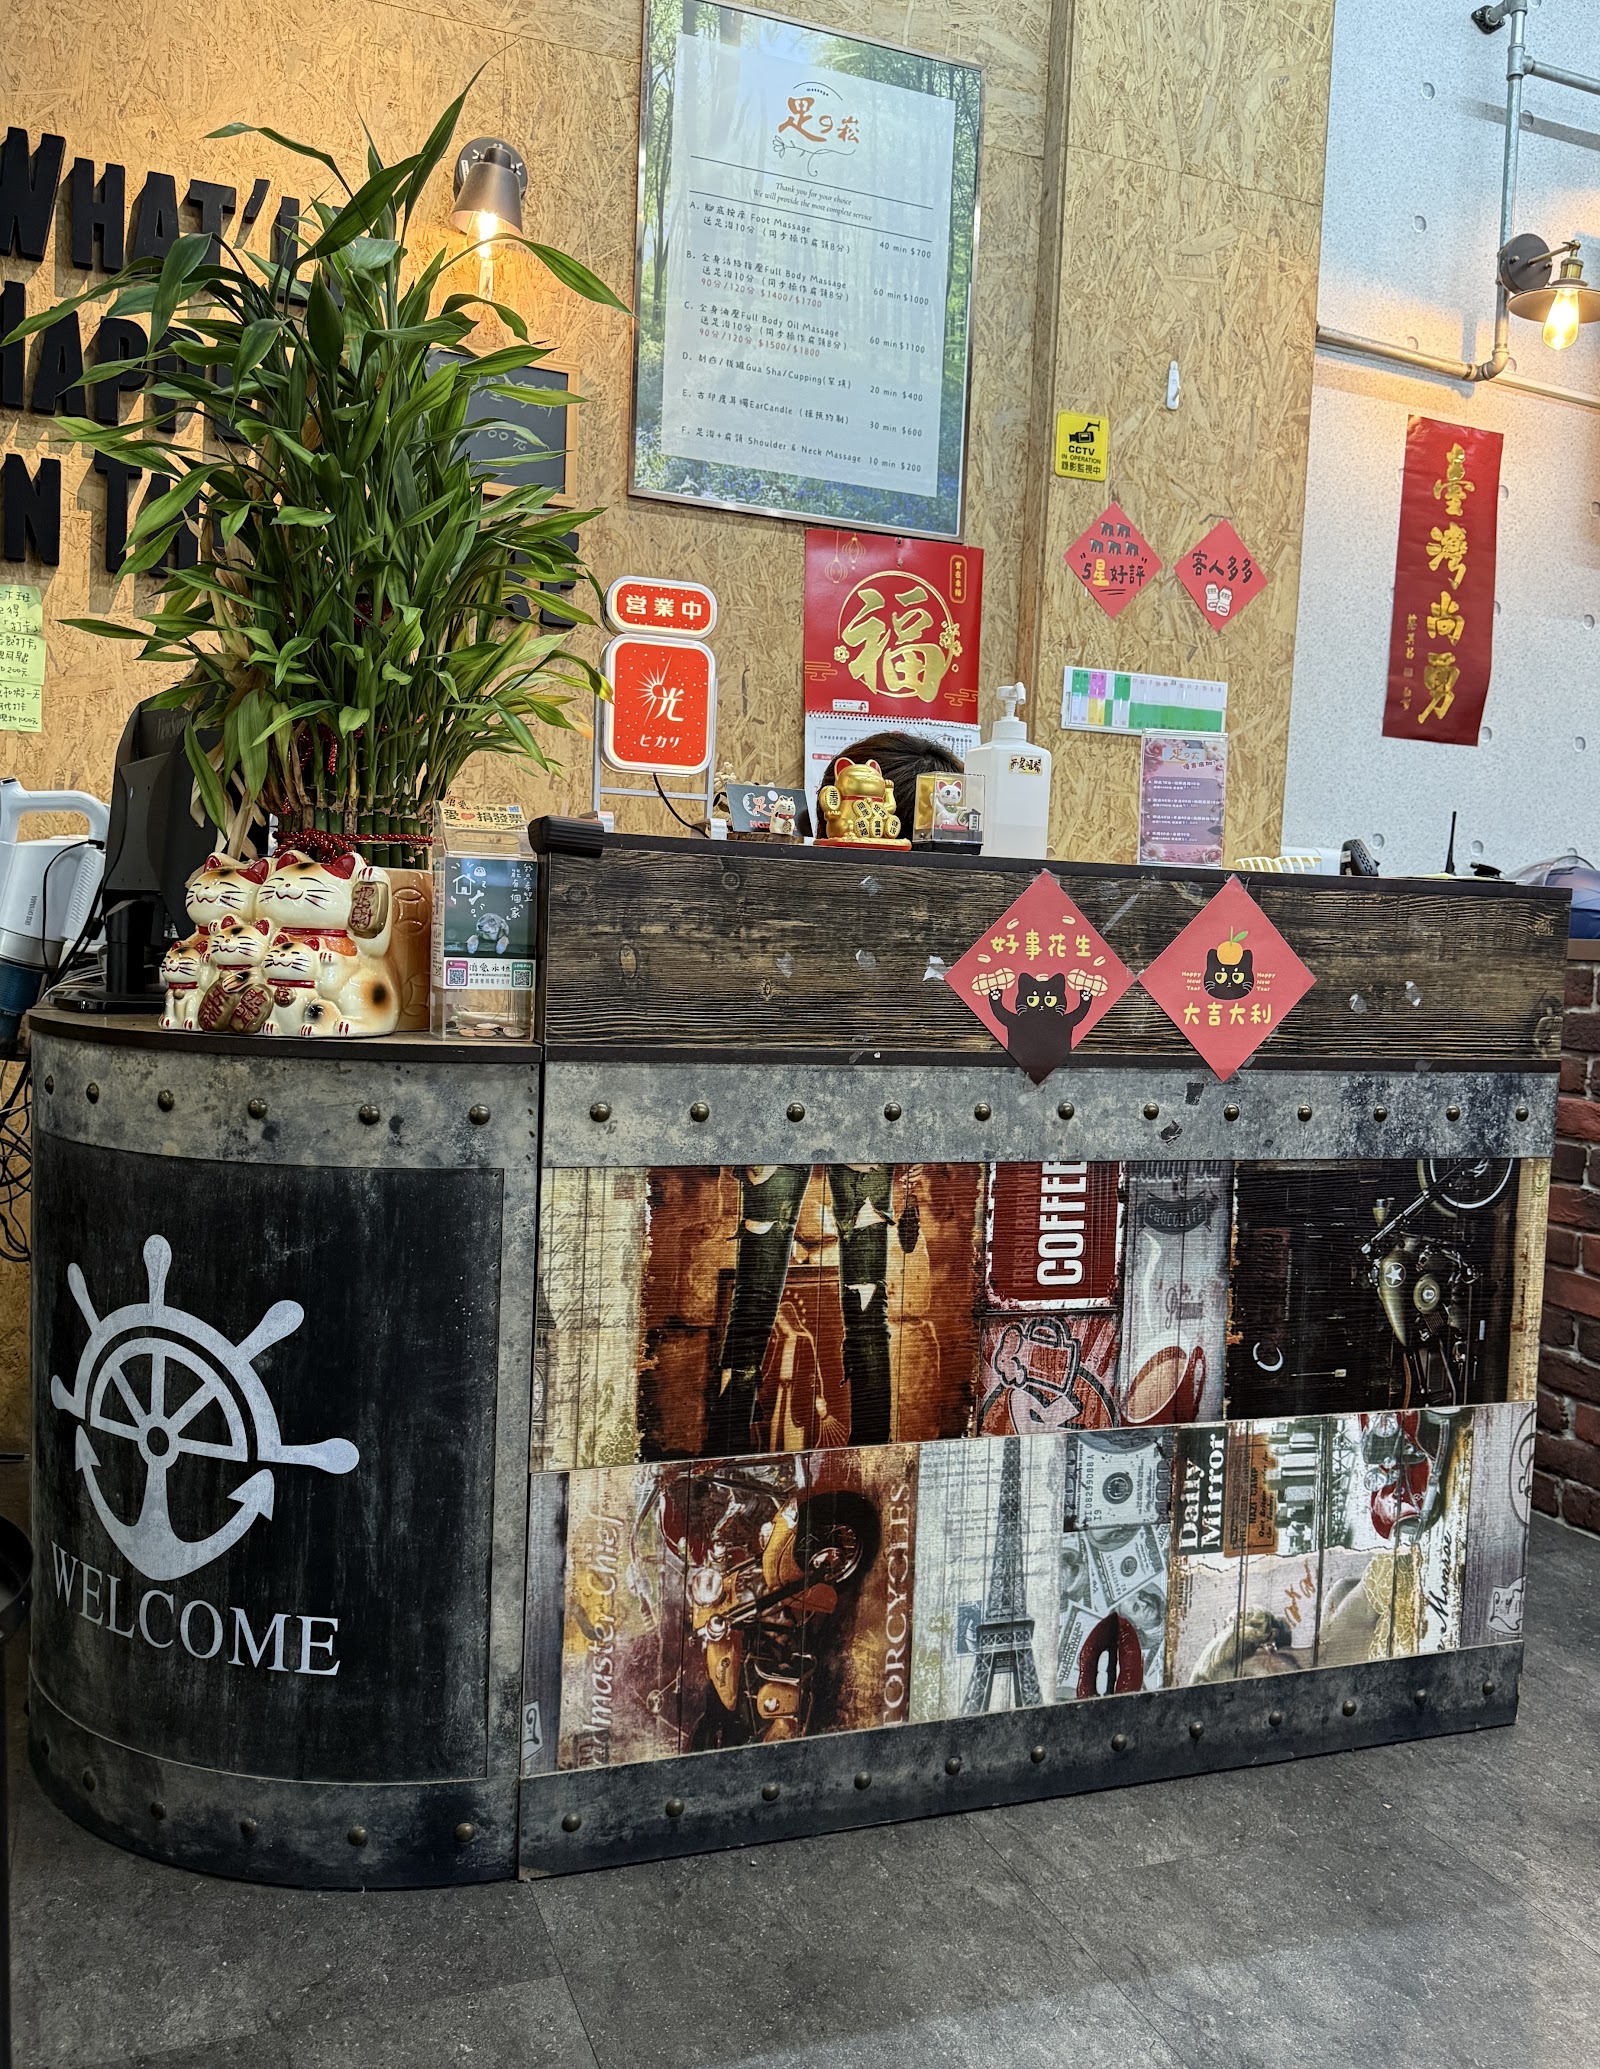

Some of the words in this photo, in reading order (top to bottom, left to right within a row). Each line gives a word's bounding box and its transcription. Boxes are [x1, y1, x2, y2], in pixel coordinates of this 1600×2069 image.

[753, 189, 763, 197] We
[764, 191, 776, 200] will
[777, 194, 799, 206] provide
[800, 198, 810, 208] the
[811, 202, 826, 211] most
[826, 205, 852, 216] complete
[853, 211, 873, 221] service
[776, 182, 795, 193] Thank
[796, 187, 808, 196] you
[808, 188, 818, 198] for
[818, 192, 833, 201] your
[834, 194, 852, 206] choice
[690, 202, 700, 210] A.
[750, 212, 770, 224] Foot
[773, 217, 811, 233] Massage
[879, 241, 890, 250] 40
[911, 247, 932, 259] $700
[686, 251, 696, 260] B.
[785, 269, 807, 282] Body
[810, 274, 847, 290] Massage
[701, 278, 755, 295] 90分/120分
[760, 289, 822, 308] $1400/$1700
[873, 288, 884, 297] 60
[888, 292, 901, 300] min
[903, 292, 930, 306] $1000
[684, 301, 693, 310] C.
[762, 315, 783, 329] Body
[787, 319, 800, 330] Oil
[802, 323, 839, 338] Massage
[699, 327, 753, 345] 90分/120分
[758, 338, 821, 358] $1500/$1800
[869, 336, 880, 345] 60
[883, 340, 898, 348] min
[899, 342, 926, 354] $1100
[682, 352, 692, 361] D.
[682, 389, 691, 398] E.
[869, 385, 880, 394] 20
[883, 388, 898, 398] min
[902, 390, 923, 402] $400
[869, 421, 880, 430] 30
[882, 424, 897, 433] min
[901, 426, 923, 437] $600
[681, 426, 690, 435] F.
[748, 437, 787, 450] Shoulder
[791, 443, 797, 451] &
[801, 446, 822, 456] Neck
[825, 449, 862, 463] Massage
[1068, 445, 1095, 456] CCTV
[869, 457, 879, 465] 10
[881, 460, 896, 469] min
[901, 461, 922, 472] $200
[1070, 454, 1102, 464] OPERATION
[1192, 550, 1253, 584] 客人多多
[626, 594, 702, 620] 営業中
[841, 585, 946, 703] 福
[640, 734, 680, 749] ヒカリ
[990, 928, 1092, 961] 好事花生
[1181, 970, 1202, 979] Happy
[1256, 971, 1276, 979] Happy
[1182, 1001, 1272, 1027] 大吉大利
[1201, 1433, 1224, 1548] Mirror
[1250, 1467, 1258, 1496] CAMP
[1179, 1457, 1205, 1549] Daily
[1249, 1501, 1258, 1524] NAZI
[585, 1509, 624, 1598] Chief
[1427, 1530, 1452, 1633] Monroe
[51, 1541, 341, 1677] WELCOME
